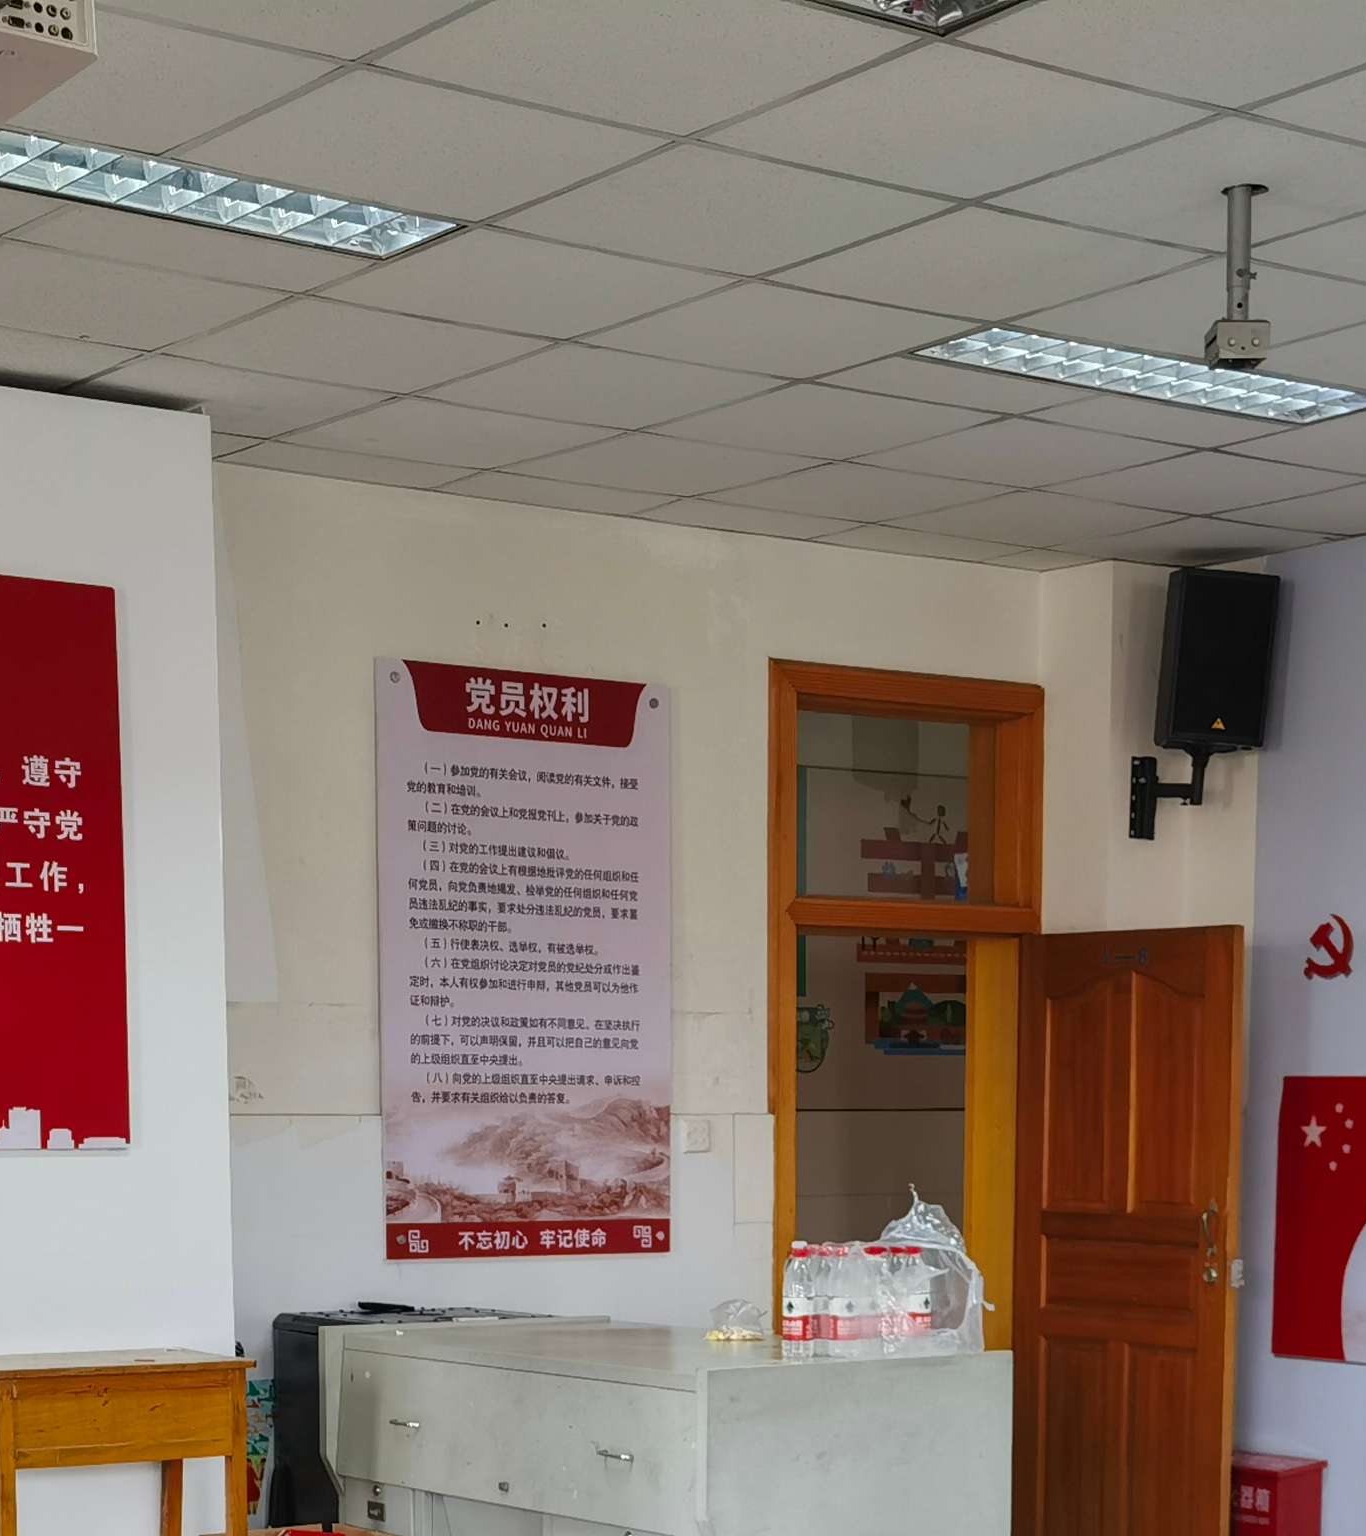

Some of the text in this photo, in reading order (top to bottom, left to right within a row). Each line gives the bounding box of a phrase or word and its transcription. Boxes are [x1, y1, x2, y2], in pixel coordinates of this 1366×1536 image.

[465, 677, 589, 723] 党员权利
[468, 717, 588, 739] DANG YUAN QUAN LI
[458, 1228, 606, 1251] 不忘初心 牢记使命
